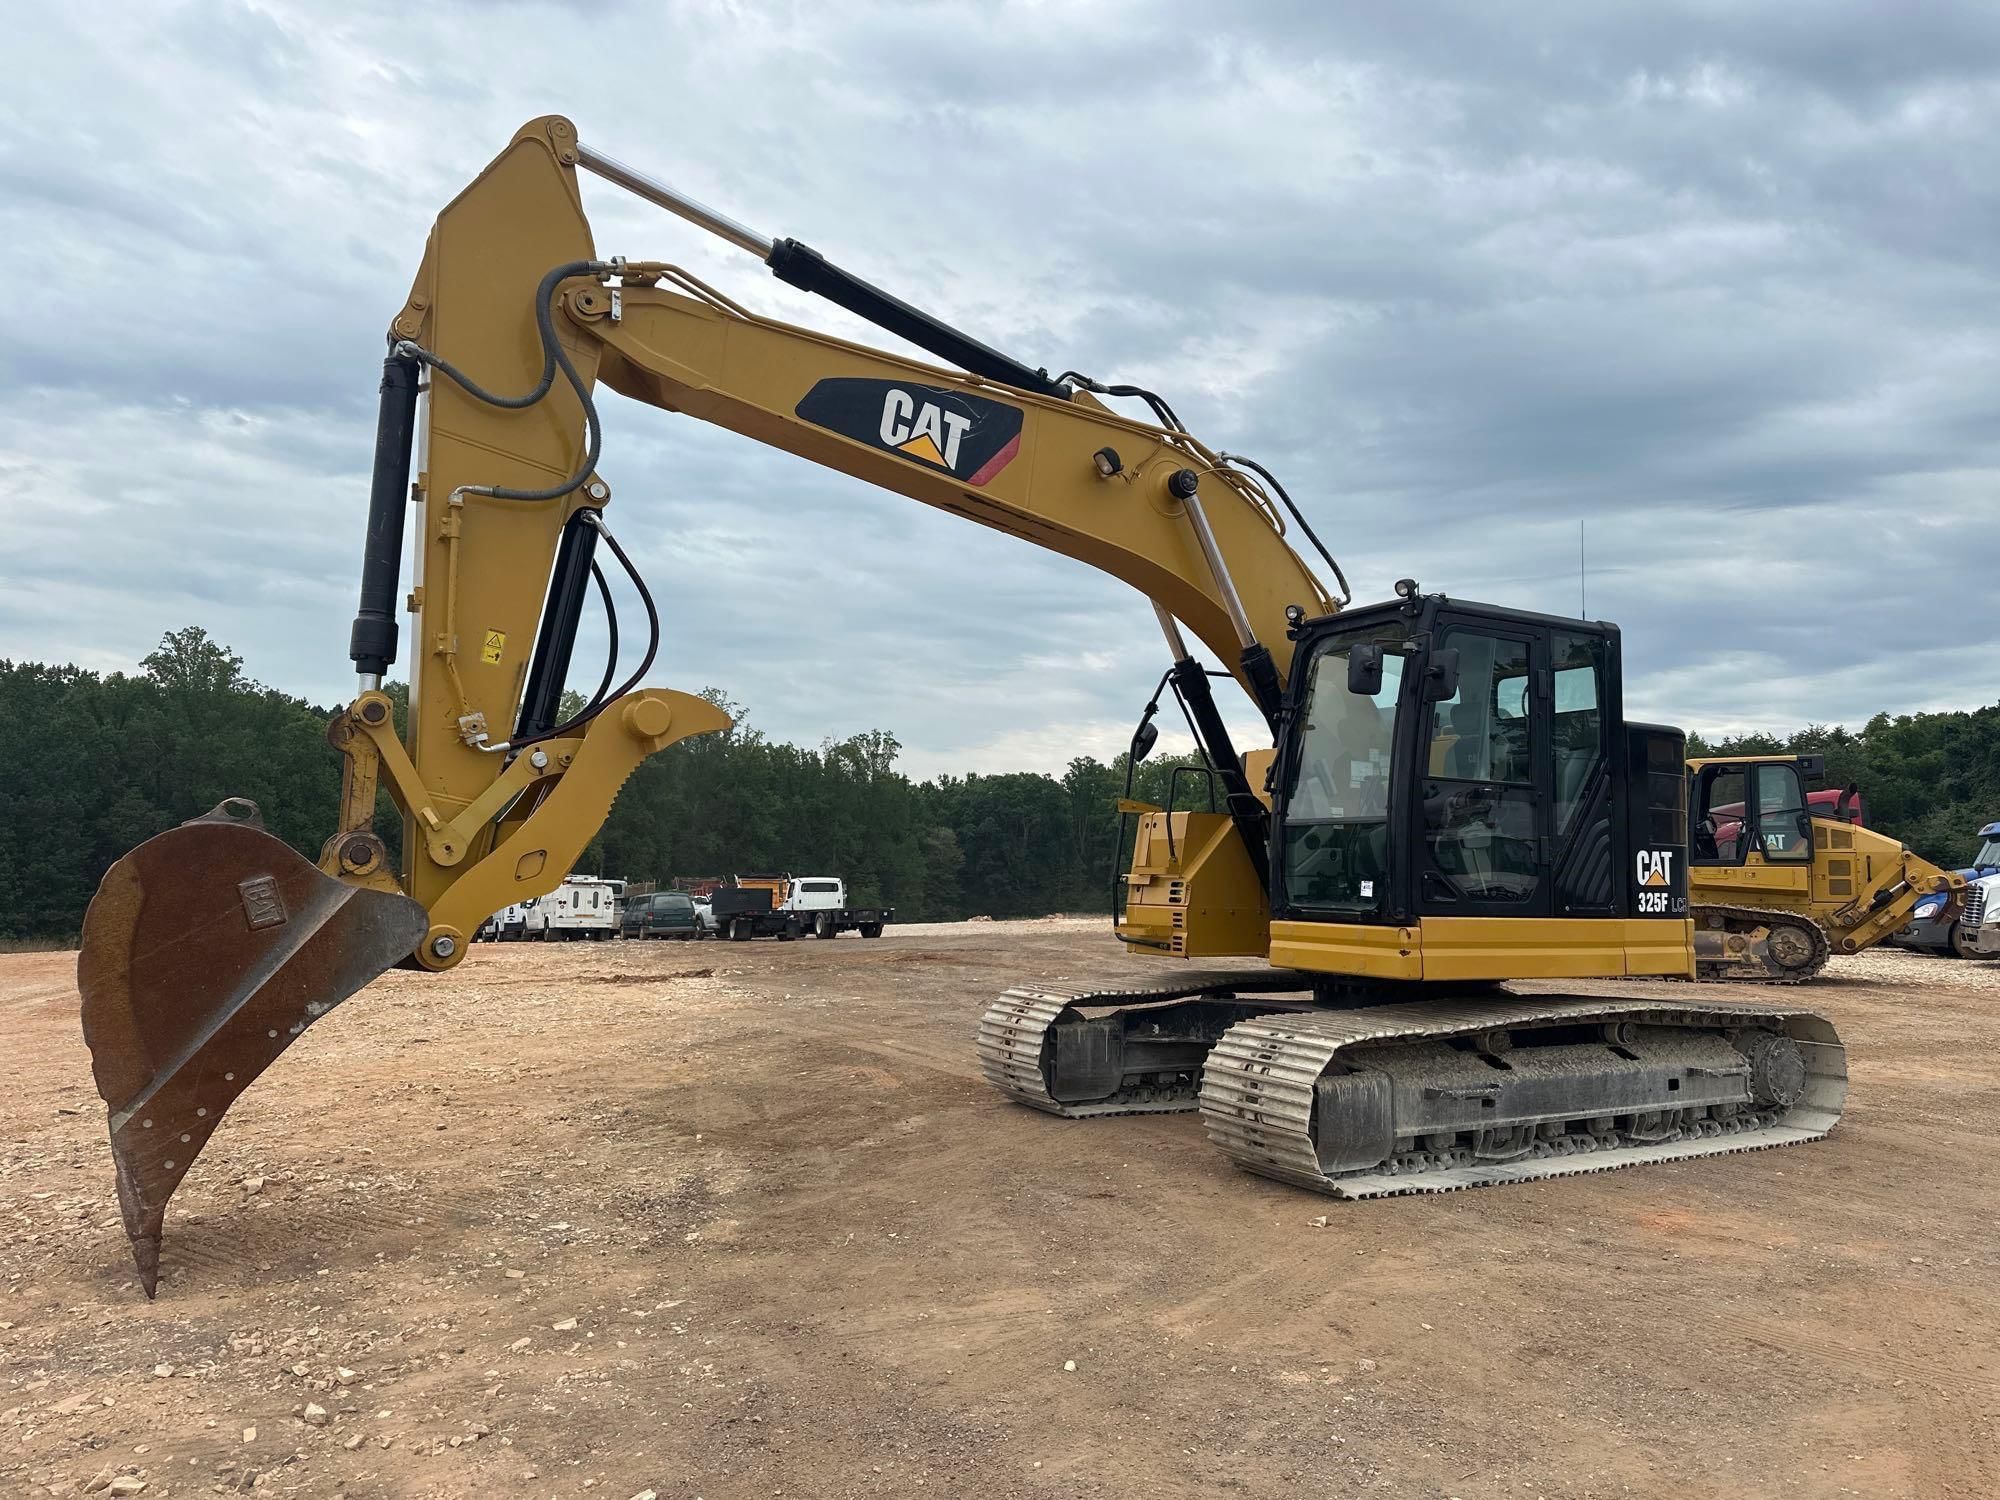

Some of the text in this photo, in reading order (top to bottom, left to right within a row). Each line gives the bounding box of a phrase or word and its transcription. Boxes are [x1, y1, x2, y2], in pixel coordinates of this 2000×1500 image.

[880, 389, 971, 470] CAT
[1637, 850, 1672, 886] CAT
[244, 882, 279, 922] CAT
[1638, 892, 1668, 912] 325F
